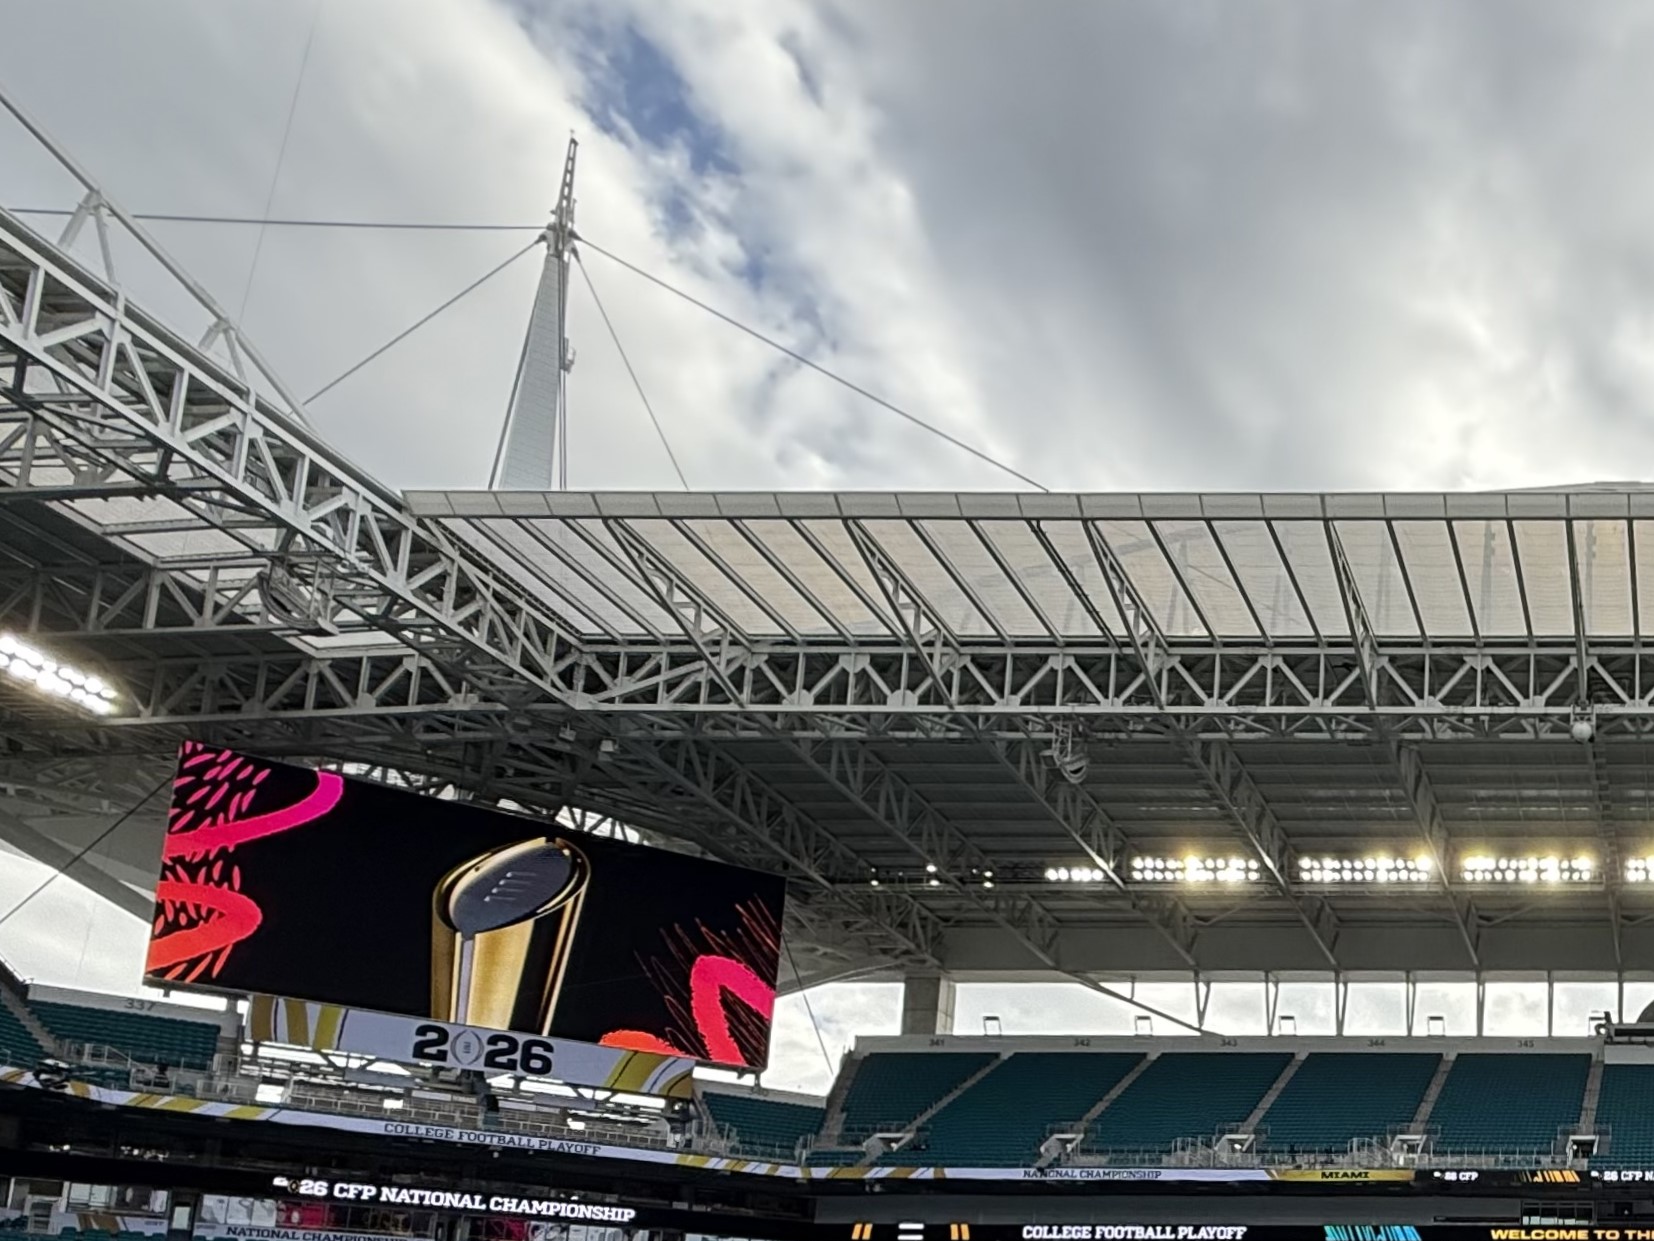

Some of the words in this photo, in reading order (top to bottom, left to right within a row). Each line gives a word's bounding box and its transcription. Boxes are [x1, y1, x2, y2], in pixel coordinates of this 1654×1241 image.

[124, 999, 157, 1012] 337
[383, 1122, 454, 1141] COLLEGE
[457, 1129, 535, 1149] FOOTBALL
[537, 1138, 602, 1156] PLAYOFF
[1079, 1168, 1162, 1181] CHAMPIONSHIP
[1320, 1169, 1371, 1180] MIAMI
[1620, 1171, 1643, 1182] CFP
[332, 1181, 378, 1201] CFP
[380, 1186, 487, 1212] NATIONAL
[488, 1195, 636, 1223] CHAMPIONSHIP
[226, 1225, 300, 1241] NATIONAL
[1022, 1225, 1093, 1241] COLLEGE
[1094, 1225, 1176, 1241] FOOTBALL
[1177, 1225, 1248, 1241] PLAYOFF
[1490, 1228, 1589, 1241] WELCOME
[1593, 1228, 1621, 1241] TO
